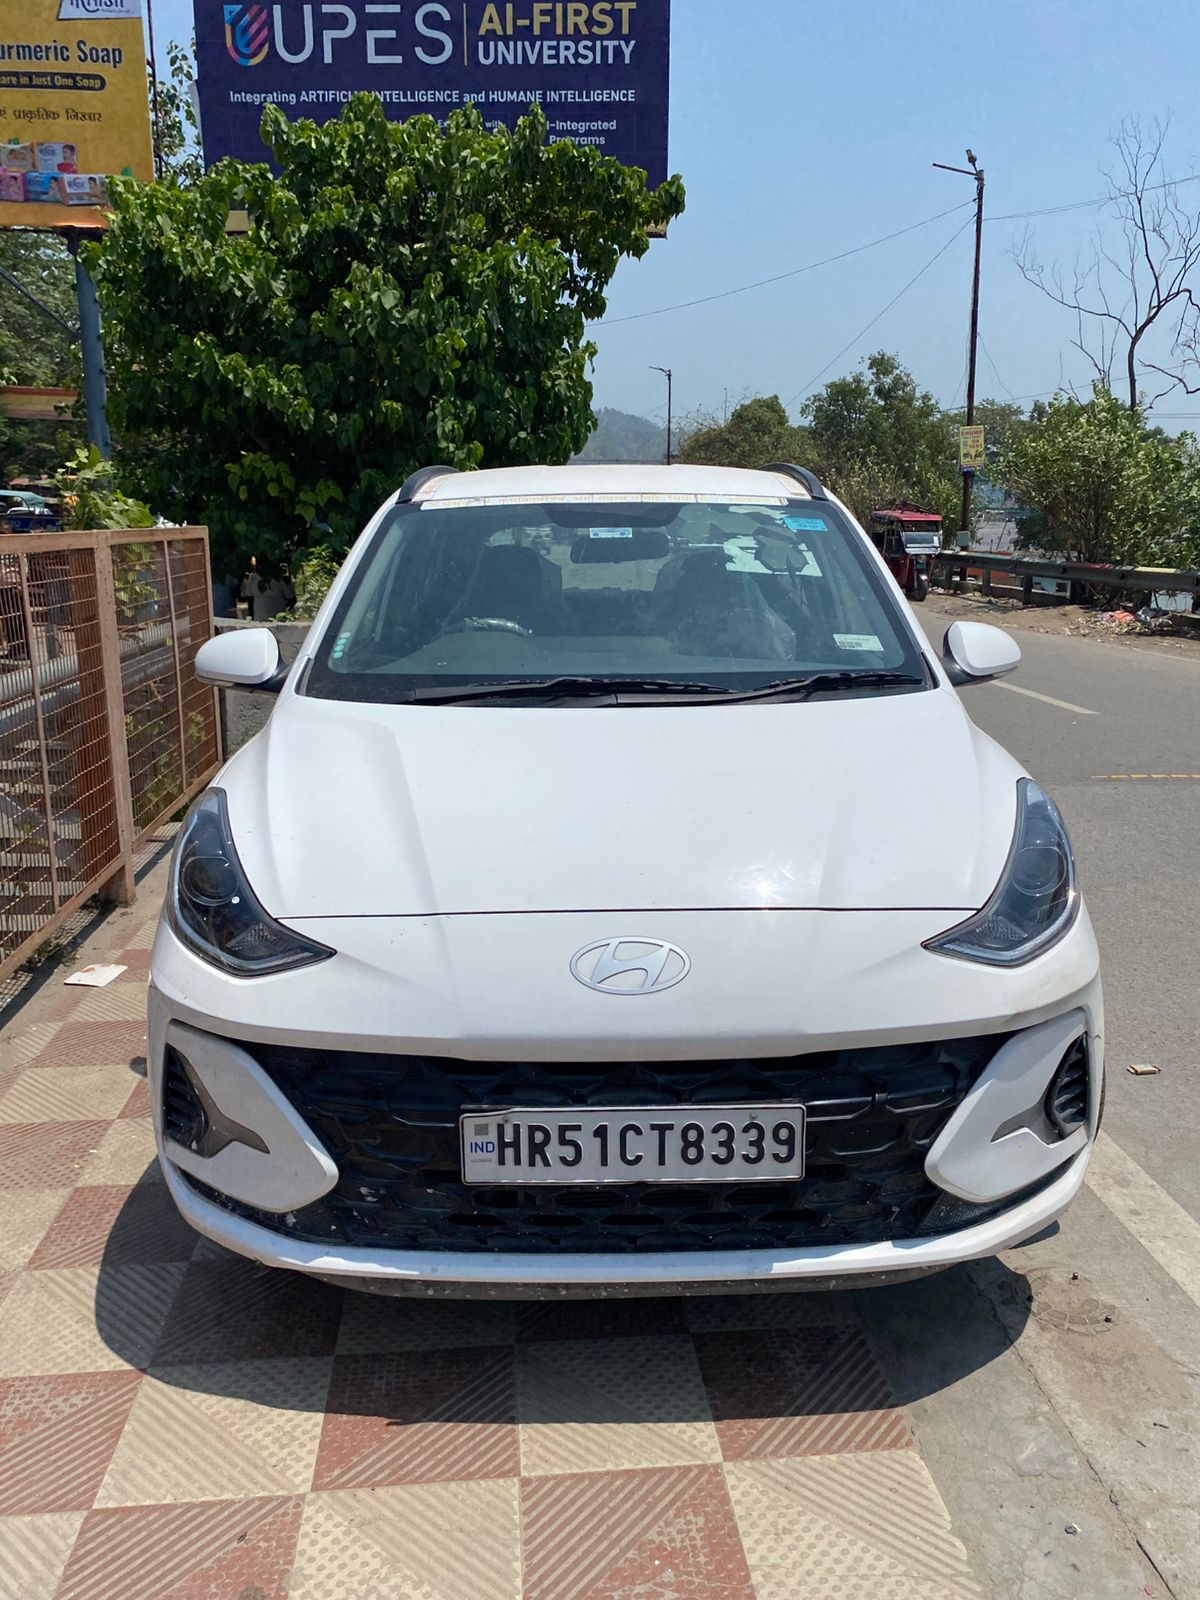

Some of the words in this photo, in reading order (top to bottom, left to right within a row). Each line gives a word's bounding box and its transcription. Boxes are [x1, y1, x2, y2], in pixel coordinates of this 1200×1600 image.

[477, 1, 637, 36] AI-FIRST
[272, 2, 453, 65] UPES
[76, 39, 122, 69] Soap
[477, 40, 636, 65] UNIVERSITY
[20, 74, 30, 85] in
[32, 74, 52, 87] Just
[54, 75, 74, 87] One
[76, 76, 101, 89] Soap
[229, 90, 297, 105] Integrating
[299, 90, 369, 103] ARTIFICI
[463, 90, 485, 103] and
[489, 90, 543, 103] HUMANE
[546, 89, 636, 103] INTELLIGENCE
[13, 106, 60, 124] प्राकृतिक
[65, 106, 103, 123] निखार
[546, 120, 617, 133] I-Integrated
[549, 135, 606, 146] Prrams
[470, 1141, 495, 1153] IND
[497, 1121, 796, 1167] HR51CT8339
